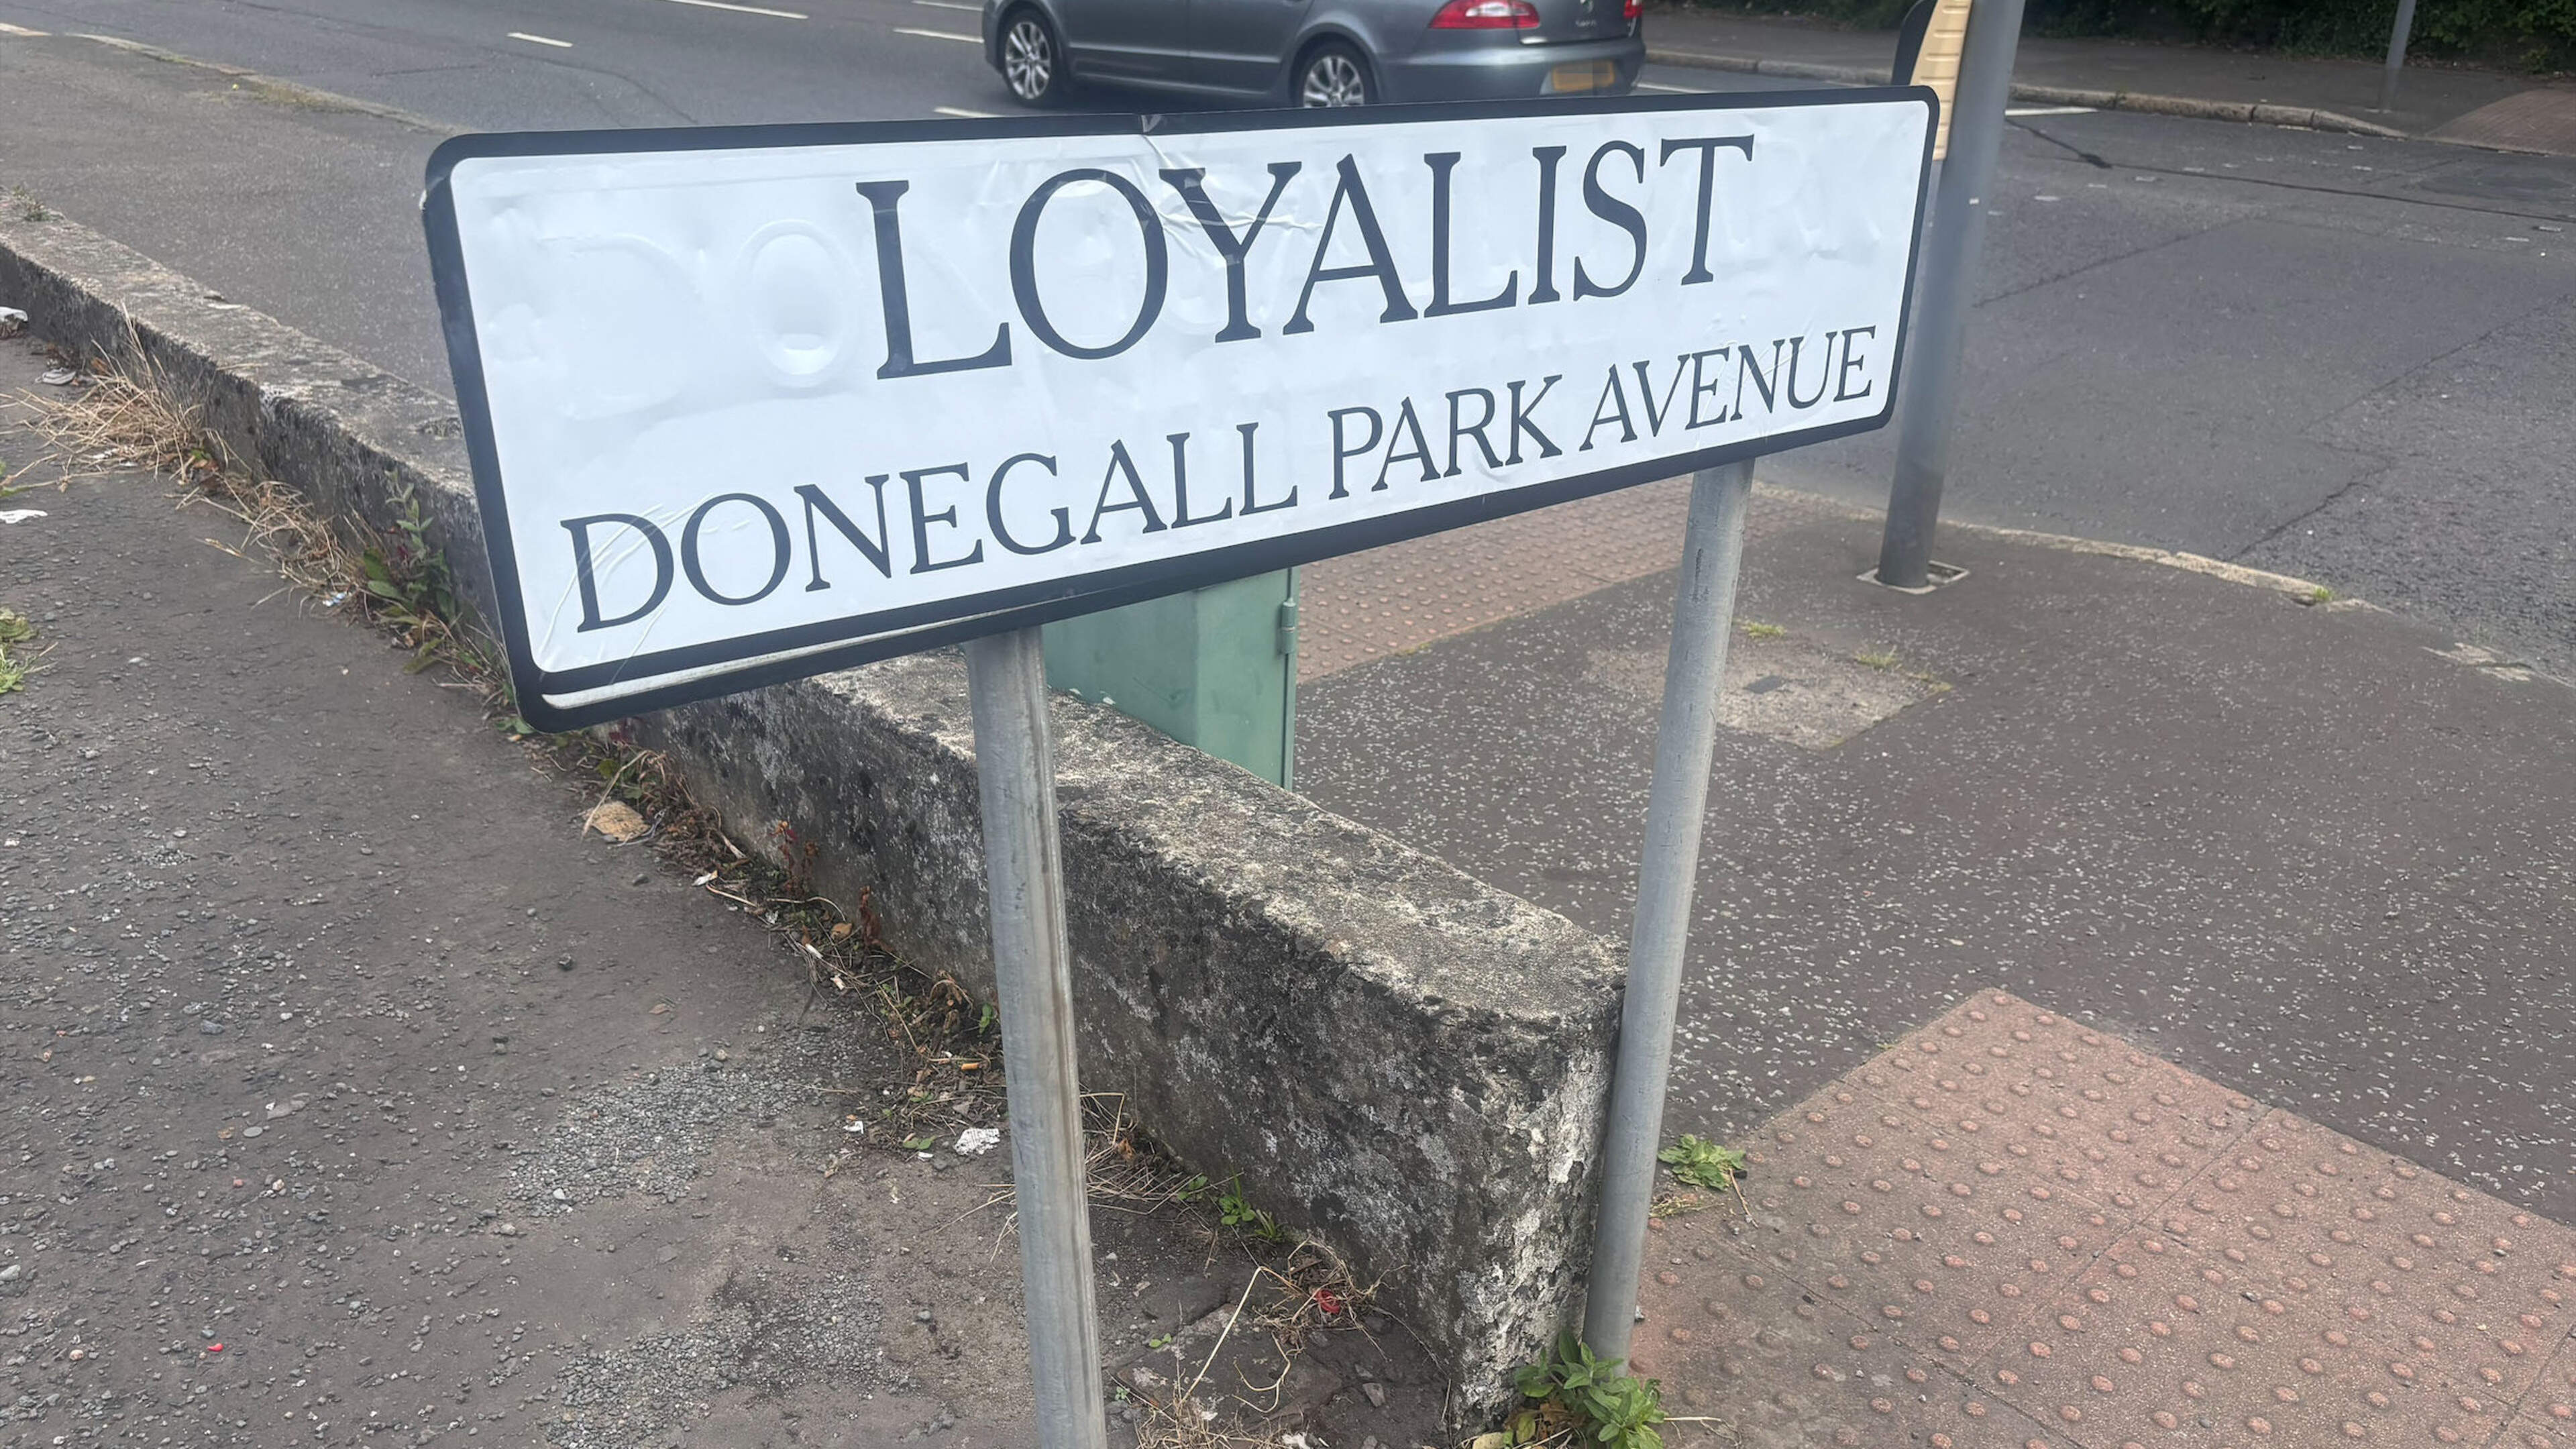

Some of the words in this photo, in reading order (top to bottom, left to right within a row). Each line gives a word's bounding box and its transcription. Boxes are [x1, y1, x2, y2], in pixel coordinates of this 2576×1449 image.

[856, 134, 1754, 380] LOYALIST
[560, 423, 1297, 633] DONEGALL
[1328, 374, 1562, 500] PARK
[1579, 325, 1876, 451] AVENUE
